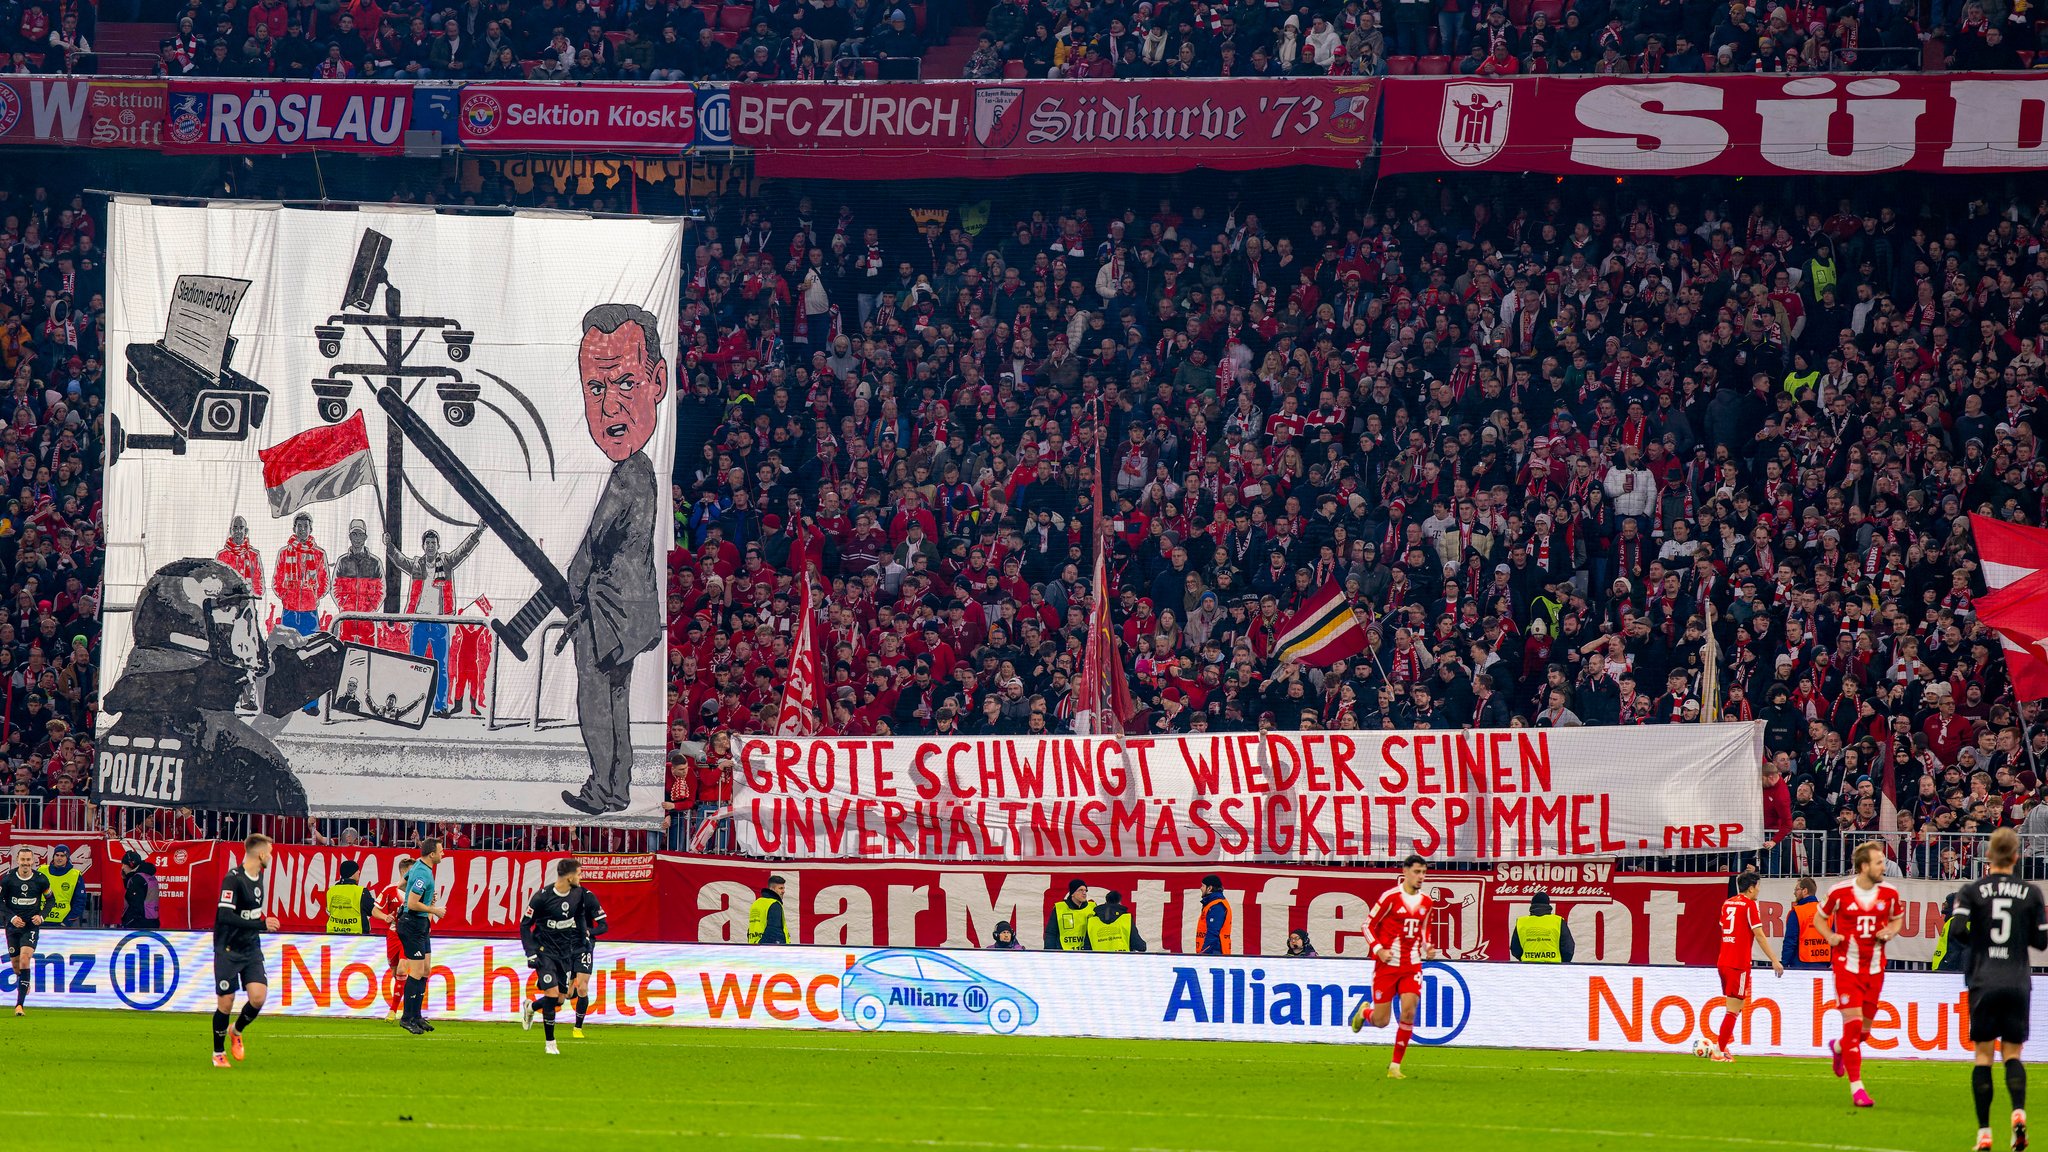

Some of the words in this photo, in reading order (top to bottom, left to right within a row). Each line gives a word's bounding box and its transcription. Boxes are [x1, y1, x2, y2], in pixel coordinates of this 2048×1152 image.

[92, 90, 163, 107] Sektion
[209, 89, 407, 146] RÖSLAU
[506, 103, 600, 126] Sektion
[738, 95, 814, 137] BFC
[817, 92, 960, 137] ZÜRICH
[1026, 94, 1248, 144] Südkurve
[1258, 94, 1324, 139] '73
[91, 117, 164, 145] Suff
[177, 280, 237, 316] Stadionverbot
[413, 665, 428, 673] REC
[98, 751, 184, 802] POLIZEI
[740, 738, 898, 798] GROTE
[913, 738, 1156, 799] SCHWINGT
[1177, 733, 1366, 797] WIEDER
[1379, 731, 1553, 795] SEINEN
[1663, 822, 1744, 849] MRP
[1496, 862, 1578, 883] Sektion
[1582, 862, 1612, 883] SV
[1495, 882, 1519, 895] des
[1522, 882, 1548, 894] sitz
[1551, 885, 1575, 895] ma
[1978, 882, 1997, 899] ST.
[1997, 881, 2031, 901] PAULI
[1723, 906, 1737, 935] 3
[1989, 897, 2013, 945] 5
[581, 952, 592, 964] 28
[889, 986, 959, 1008] Allianz
[1162, 966, 1378, 1028] Allianz
